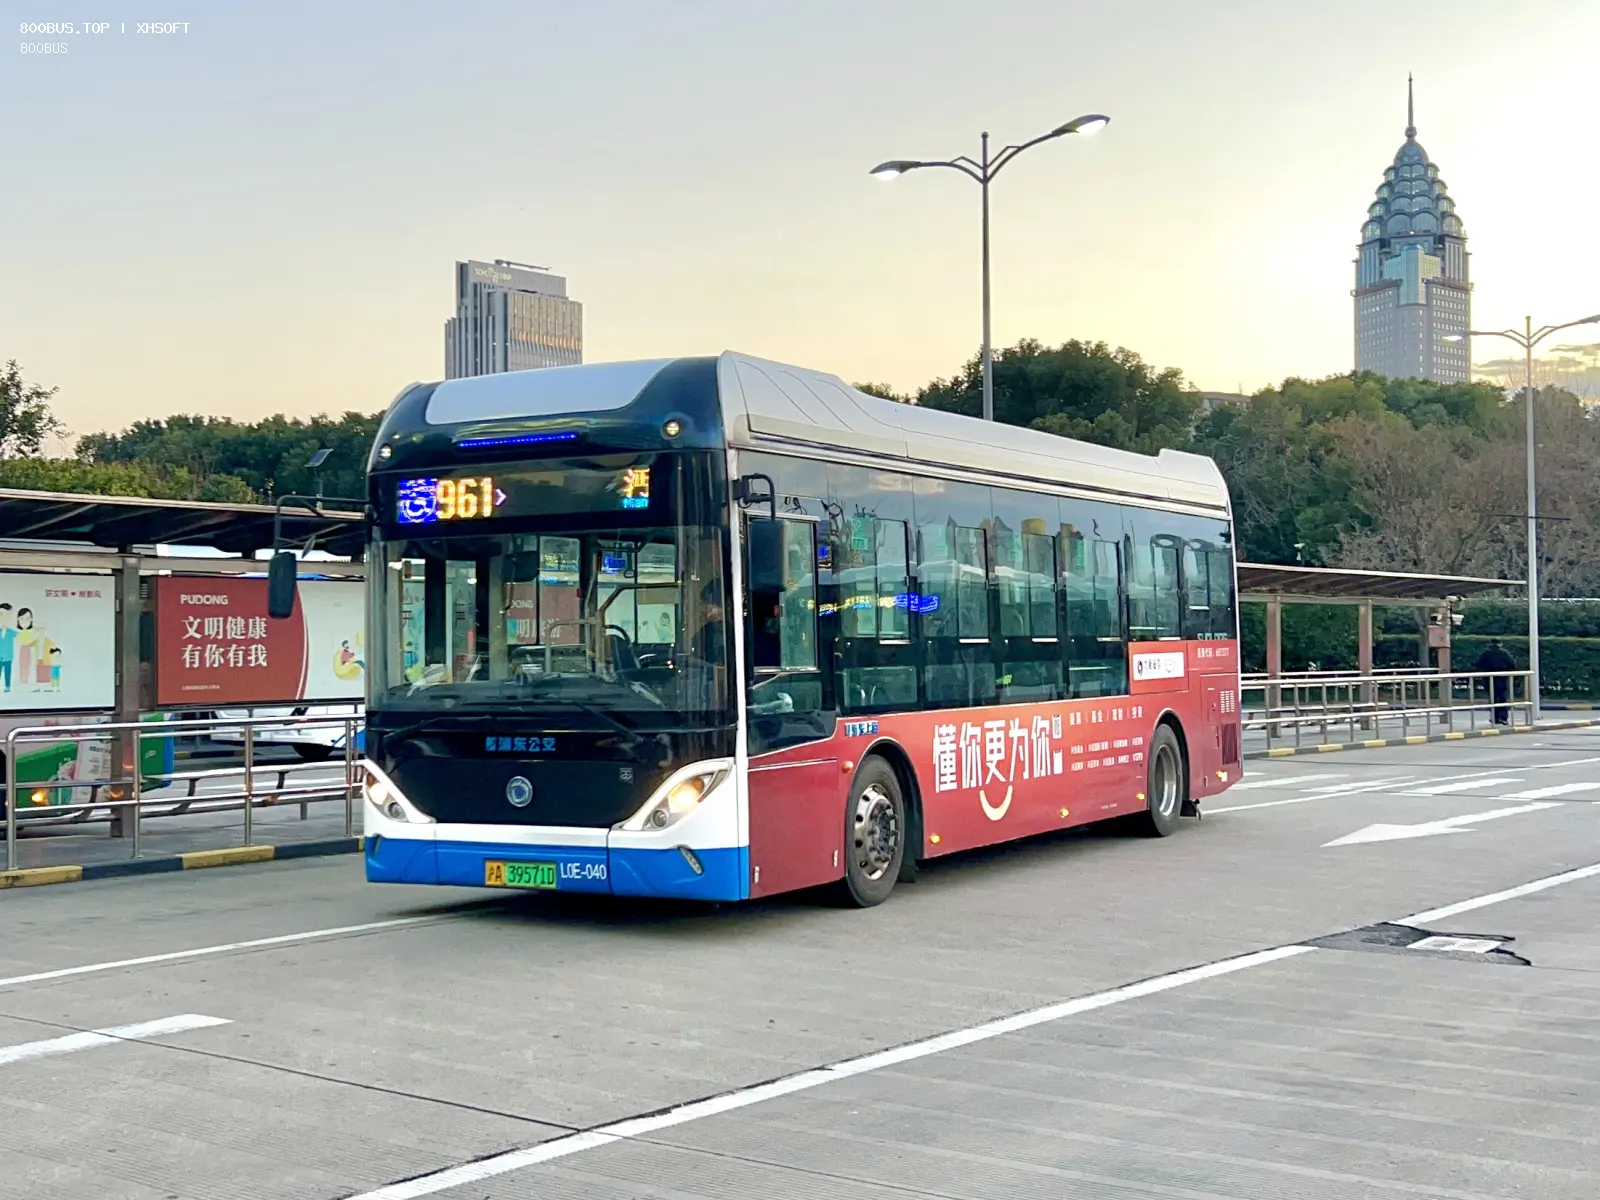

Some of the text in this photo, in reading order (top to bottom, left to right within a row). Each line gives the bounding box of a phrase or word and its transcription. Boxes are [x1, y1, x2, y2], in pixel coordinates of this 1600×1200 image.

[436, 477, 492, 519] 961
[180, 594, 228, 605] PUDONG
[182, 616, 267, 640] 文明健康
[181, 644, 267, 668] 有你有我
[932, 715, 1051, 793] 懂你更为你
